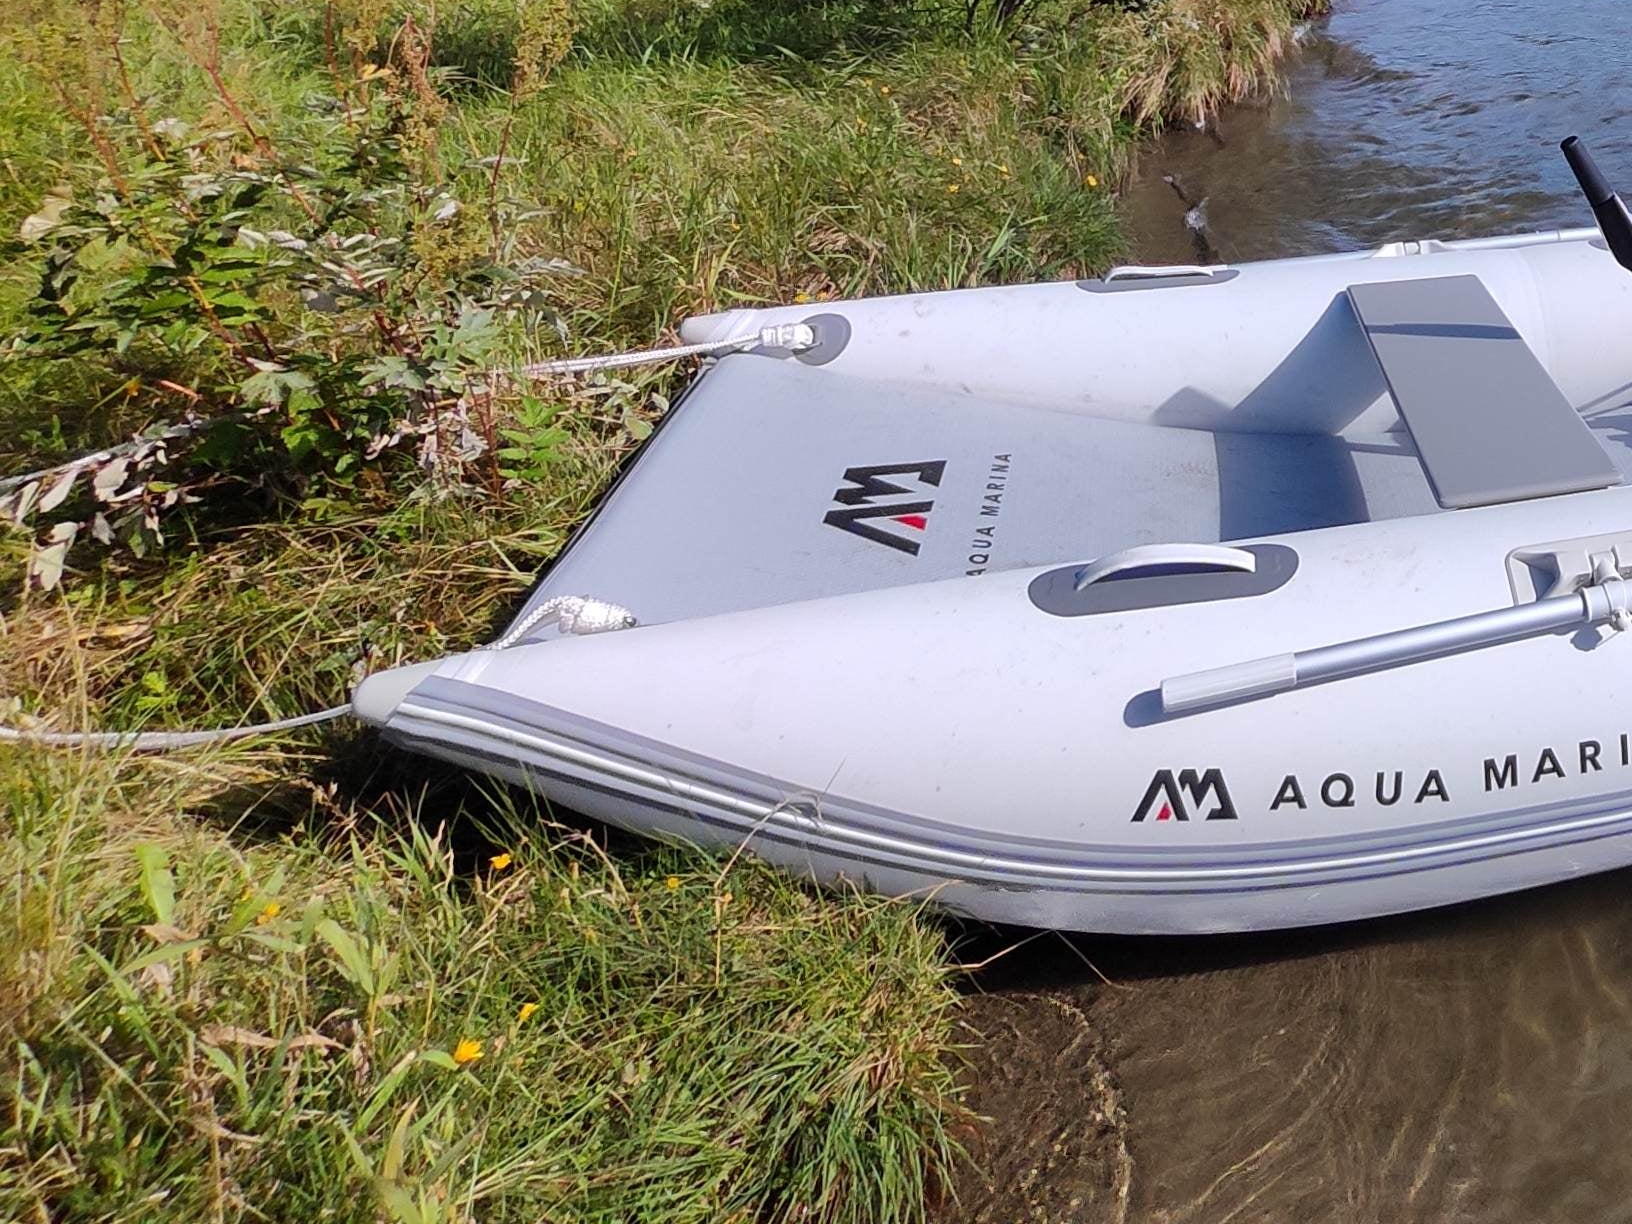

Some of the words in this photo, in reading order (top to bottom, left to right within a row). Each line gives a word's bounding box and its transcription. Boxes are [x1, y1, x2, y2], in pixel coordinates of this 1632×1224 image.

[979, 454, 1012, 517] MARINA
[965, 526, 996, 577] AQUA
[1270, 769, 1450, 811] AQUA
